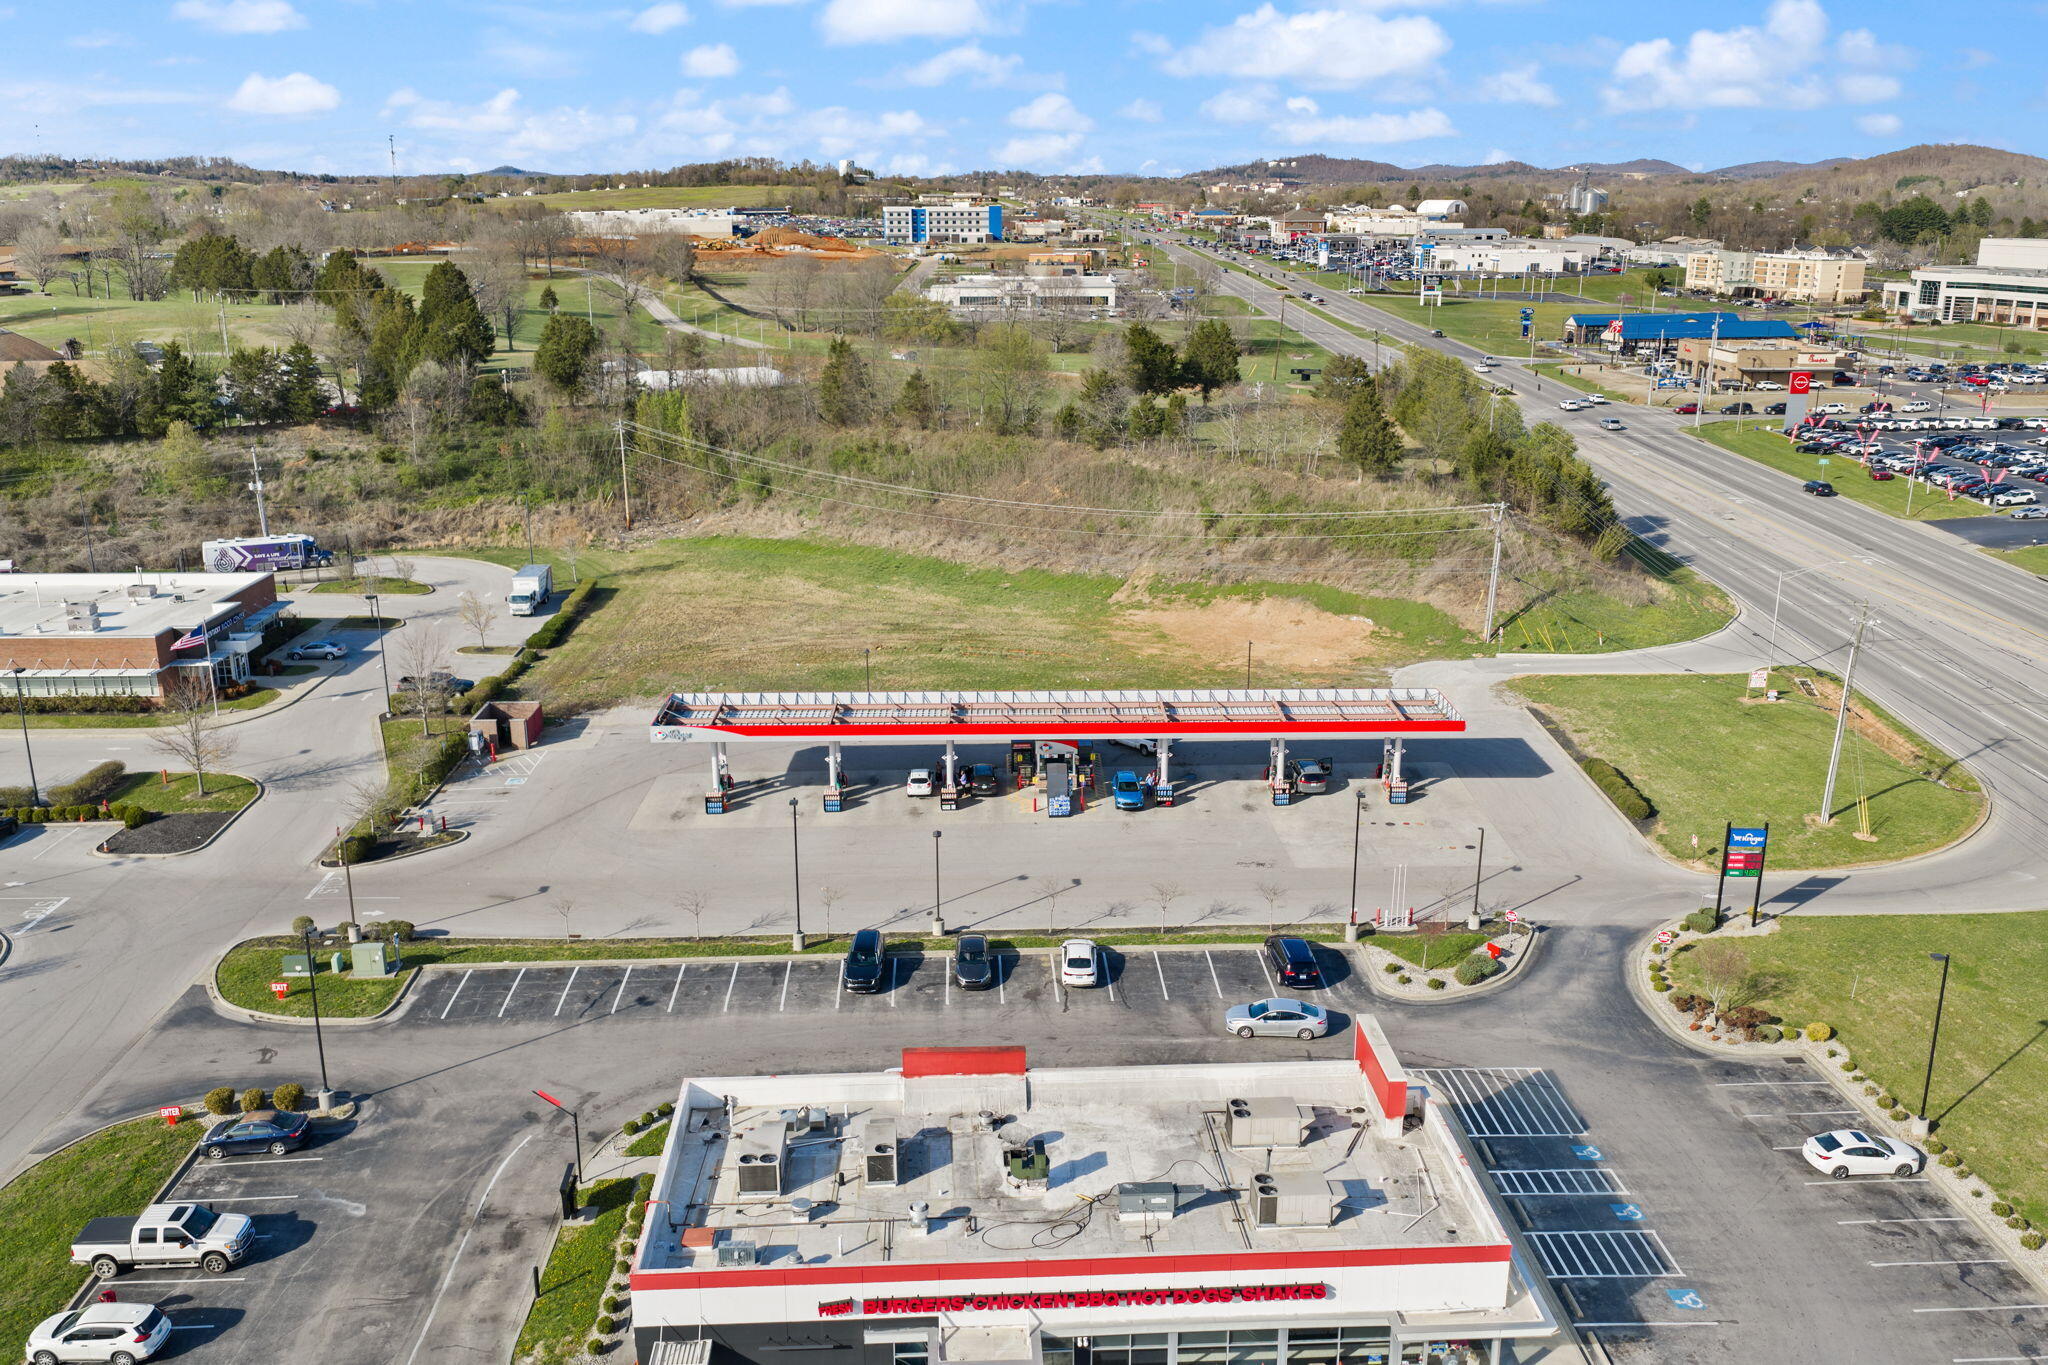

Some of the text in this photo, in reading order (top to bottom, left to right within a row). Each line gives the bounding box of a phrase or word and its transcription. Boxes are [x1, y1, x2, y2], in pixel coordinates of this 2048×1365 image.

[1742, 833, 1765, 845] Kroger
[271, 983, 287, 991] EXIT
[161, 1107, 180, 1116] ENTER
[818, 1302, 853, 1317] FRESH
[863, 1297, 970, 1315] BURGERS
[972, 1294, 1068, 1312] CHICKEN
[1172, 1287, 1234, 1304] DOGS
[1241, 1284, 1326, 1302] SHAKES
